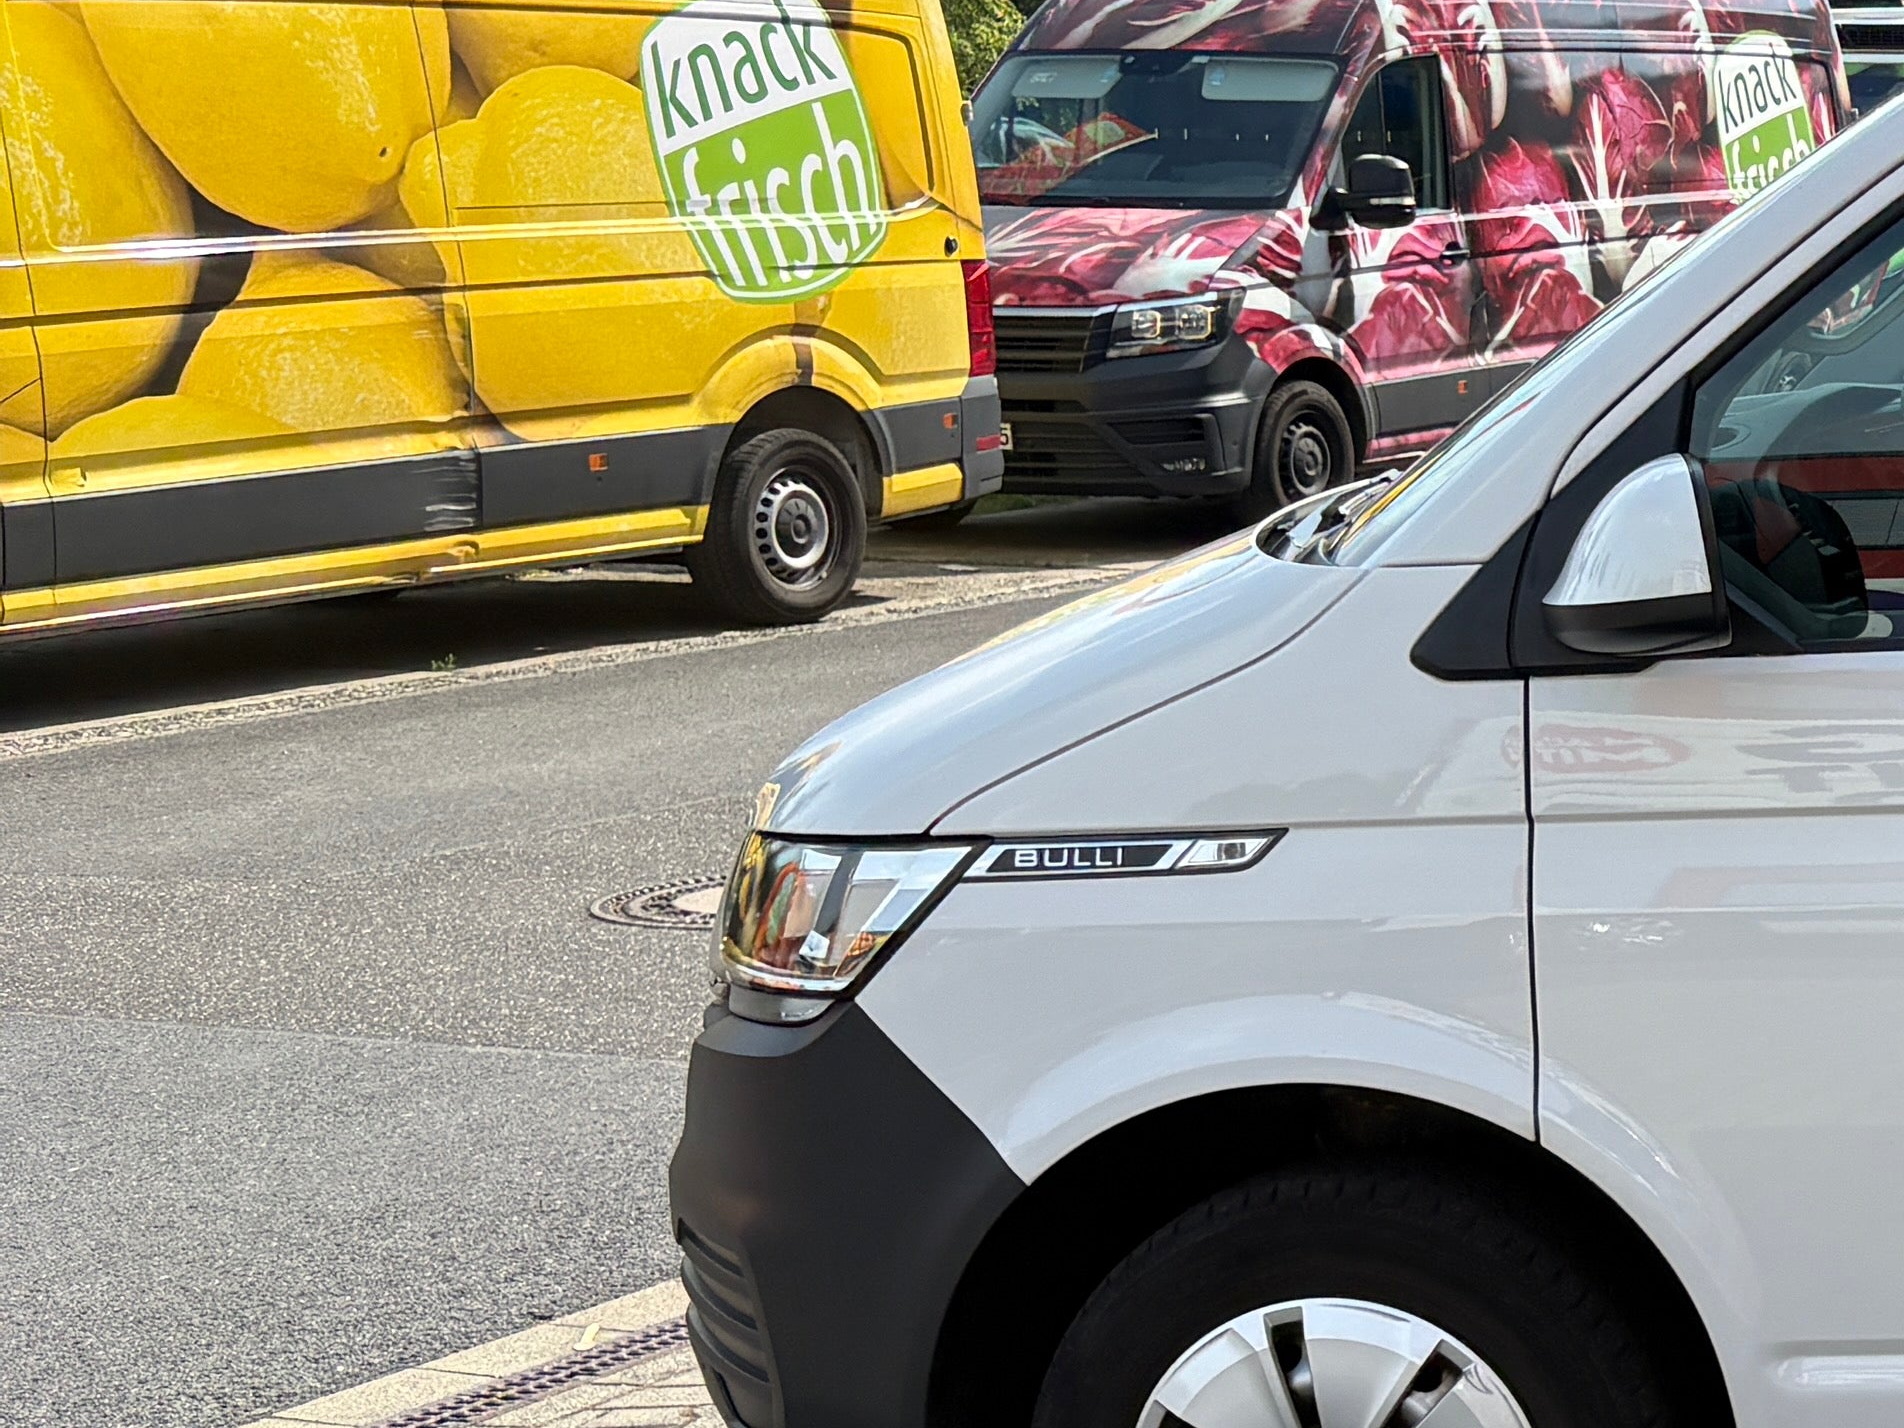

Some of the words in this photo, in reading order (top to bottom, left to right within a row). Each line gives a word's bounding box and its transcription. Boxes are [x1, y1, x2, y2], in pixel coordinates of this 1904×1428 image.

[1718, 41, 1798, 134] knack
[682, 101, 878, 287] frisch
[1014, 847, 1123, 868] BULLI
